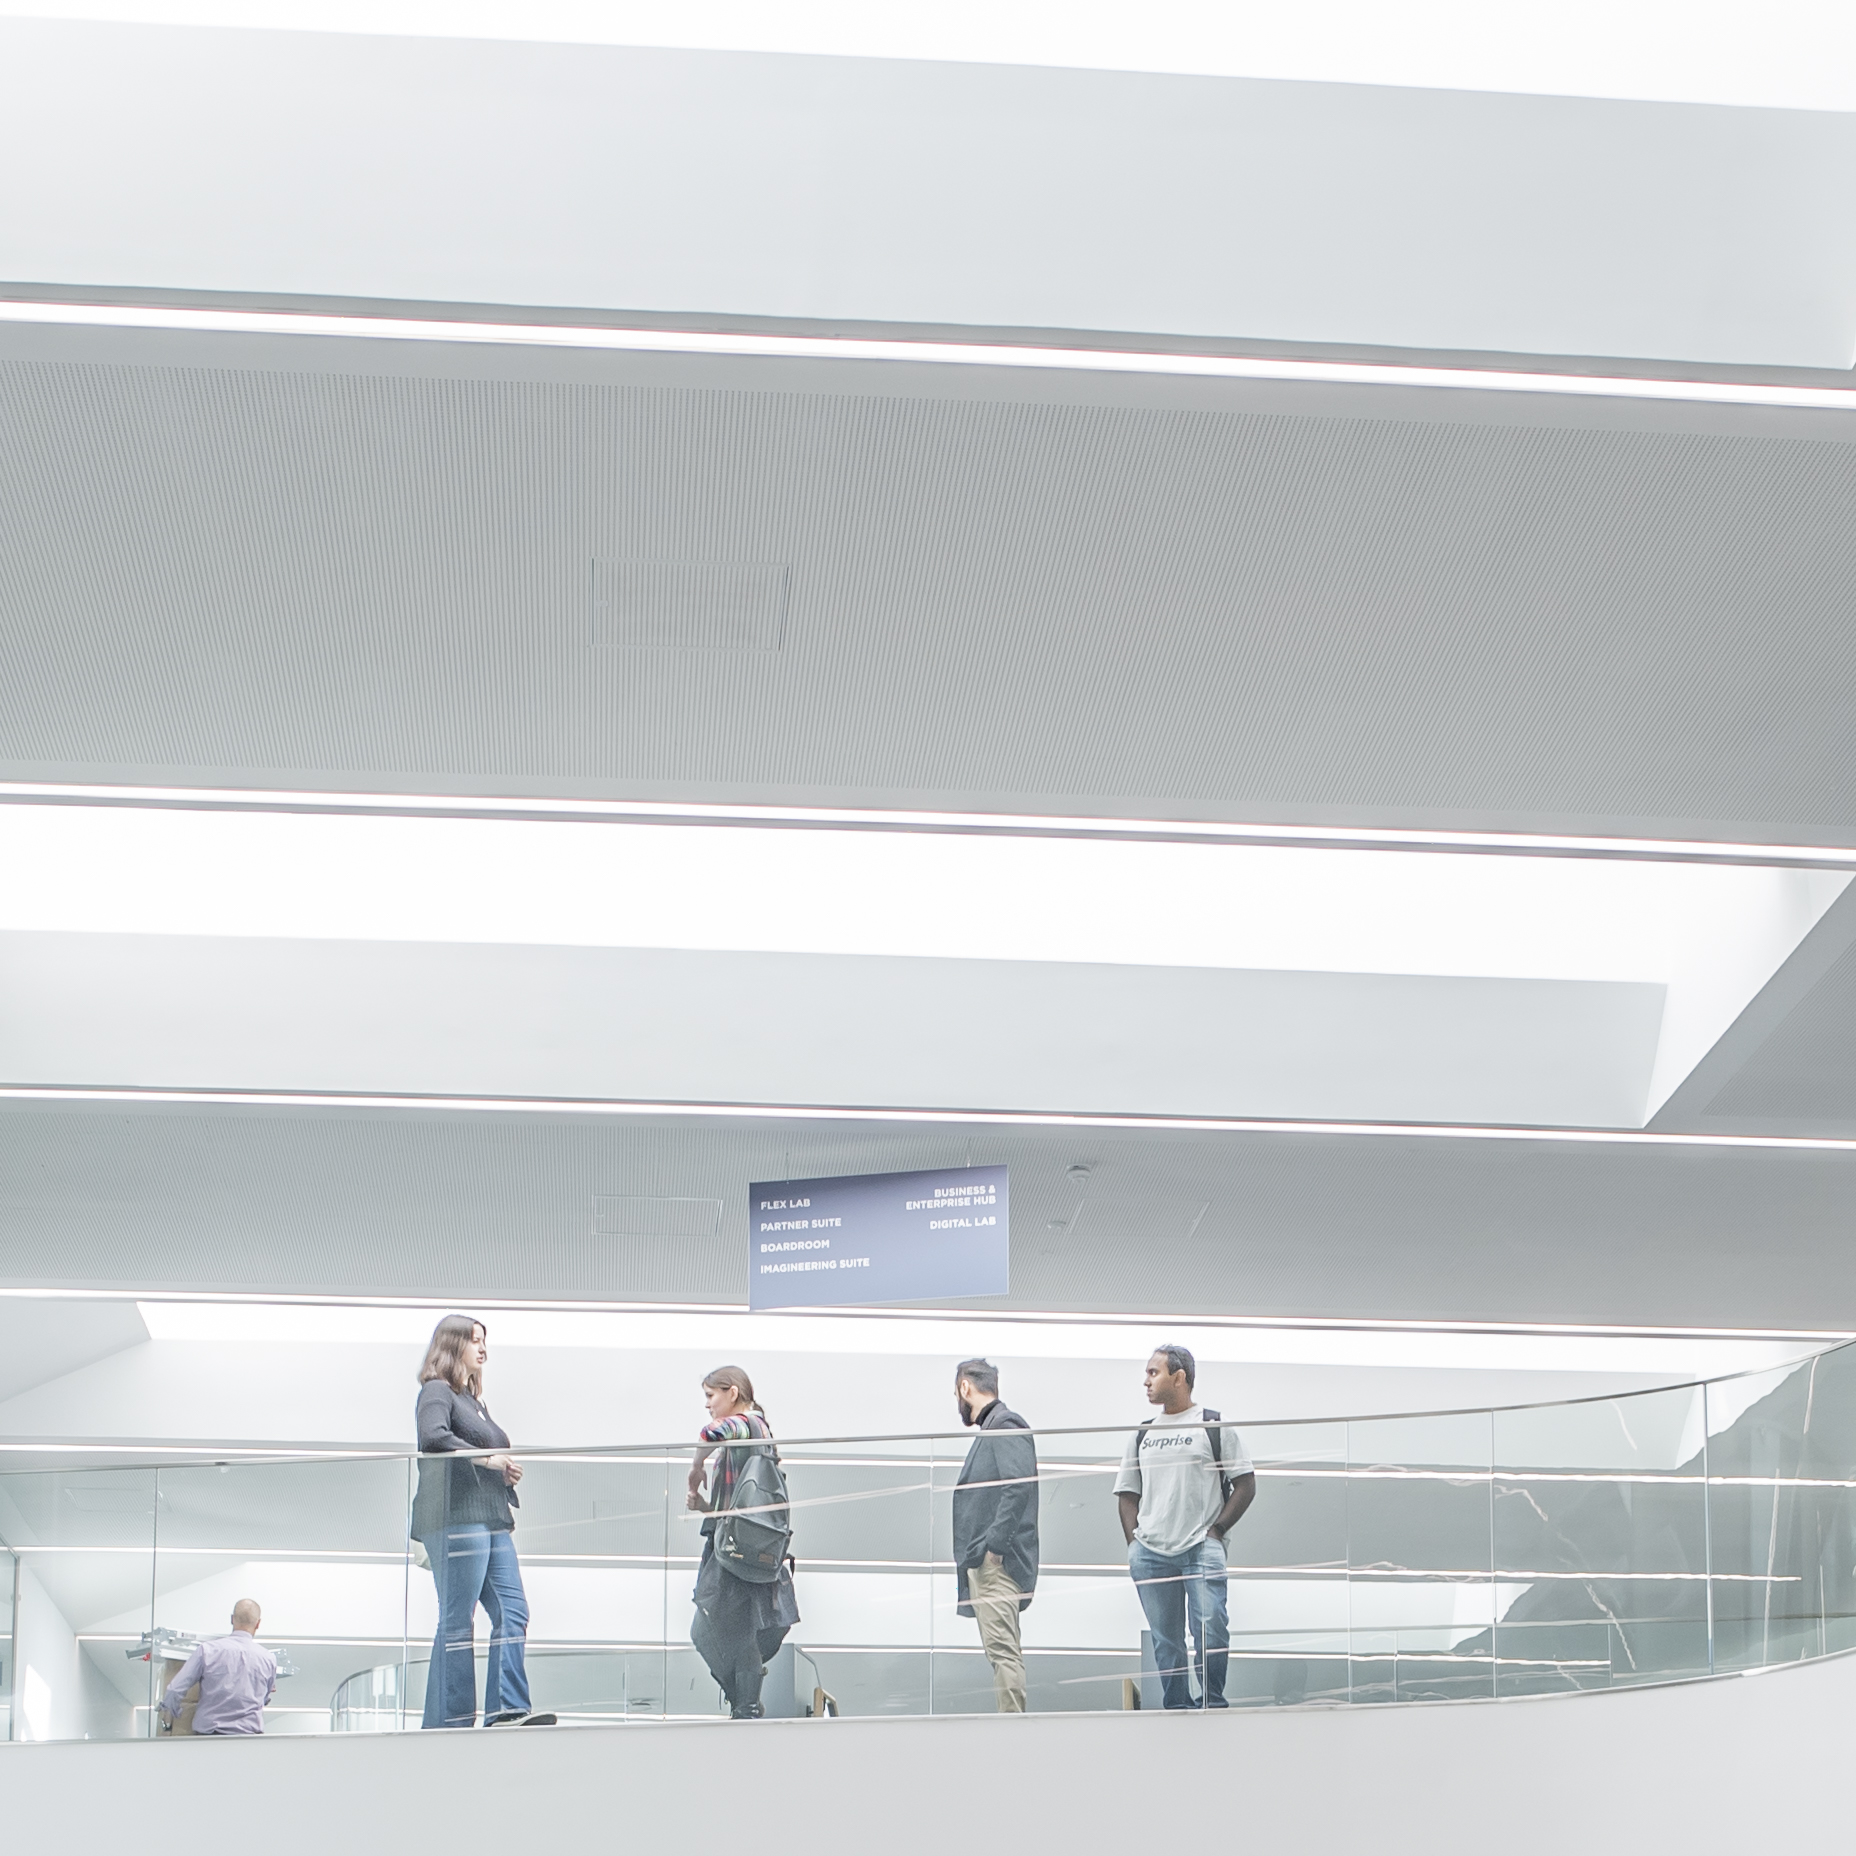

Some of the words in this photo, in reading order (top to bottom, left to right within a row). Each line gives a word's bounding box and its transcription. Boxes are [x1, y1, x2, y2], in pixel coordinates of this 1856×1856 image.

[934, 1186, 986, 1198] BUSINESS
[988, 1185, 996, 1194] &
[761, 1199, 787, 1210] FLEX
[790, 1197, 810, 1208] LAB
[906, 1197, 971, 1210] ENTERPRISE
[973, 1195, 996, 1206] HUB
[760, 1219, 809, 1232] PARTNER
[812, 1217, 842, 1228] SUITE
[930, 1217, 972, 1230] DIGITAL
[974, 1216, 996, 1227] LAB
[761, 1239, 830, 1253] BOARDROOM
[760, 1260, 837, 1274] IMAGINEERING
[840, 1258, 870, 1269] SUITE
[1142, 1434, 1193, 1450] Surprise
